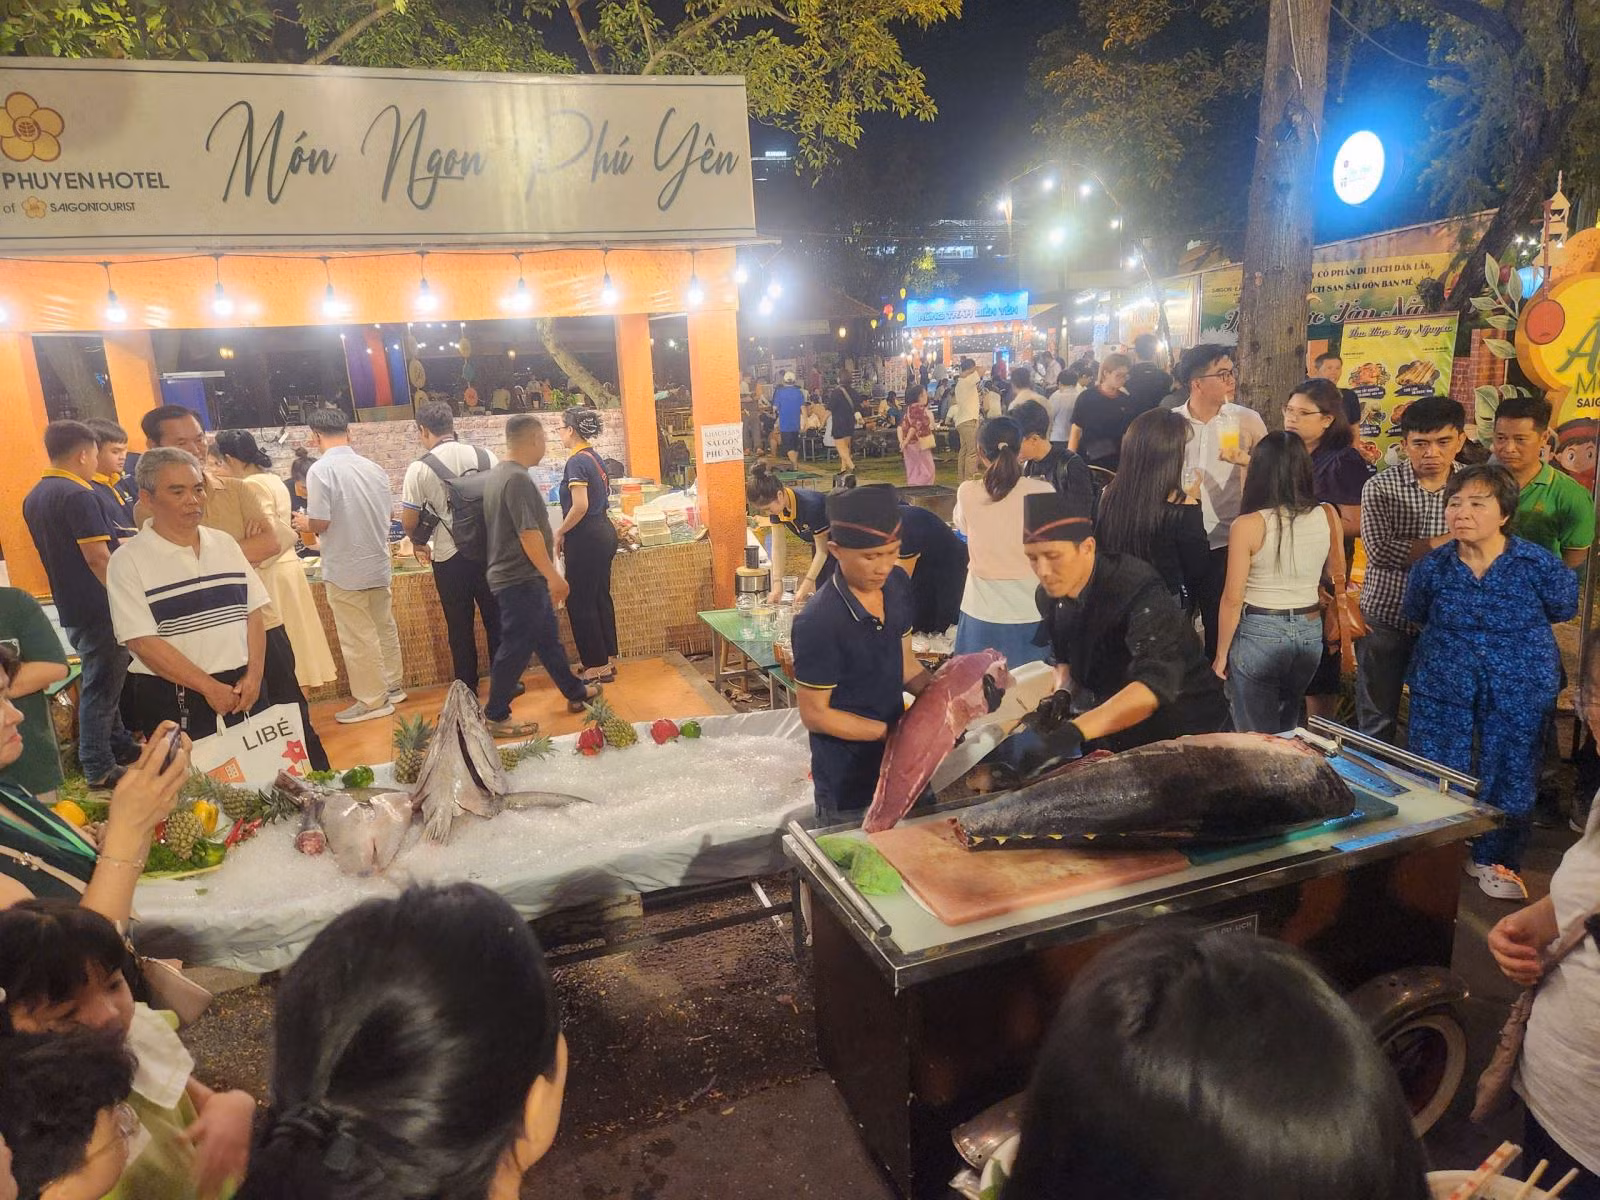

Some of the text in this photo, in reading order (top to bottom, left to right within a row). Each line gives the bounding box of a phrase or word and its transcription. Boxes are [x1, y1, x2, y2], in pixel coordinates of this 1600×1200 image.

[205, 100, 740, 212] Món Ngon Phú Yên
[2, 171, 170, 190] PHUYEN HOTEL
[2, 201, 136, 214] of SAIGONTOURIST
[242, 716, 294, 751] LIBÉ
